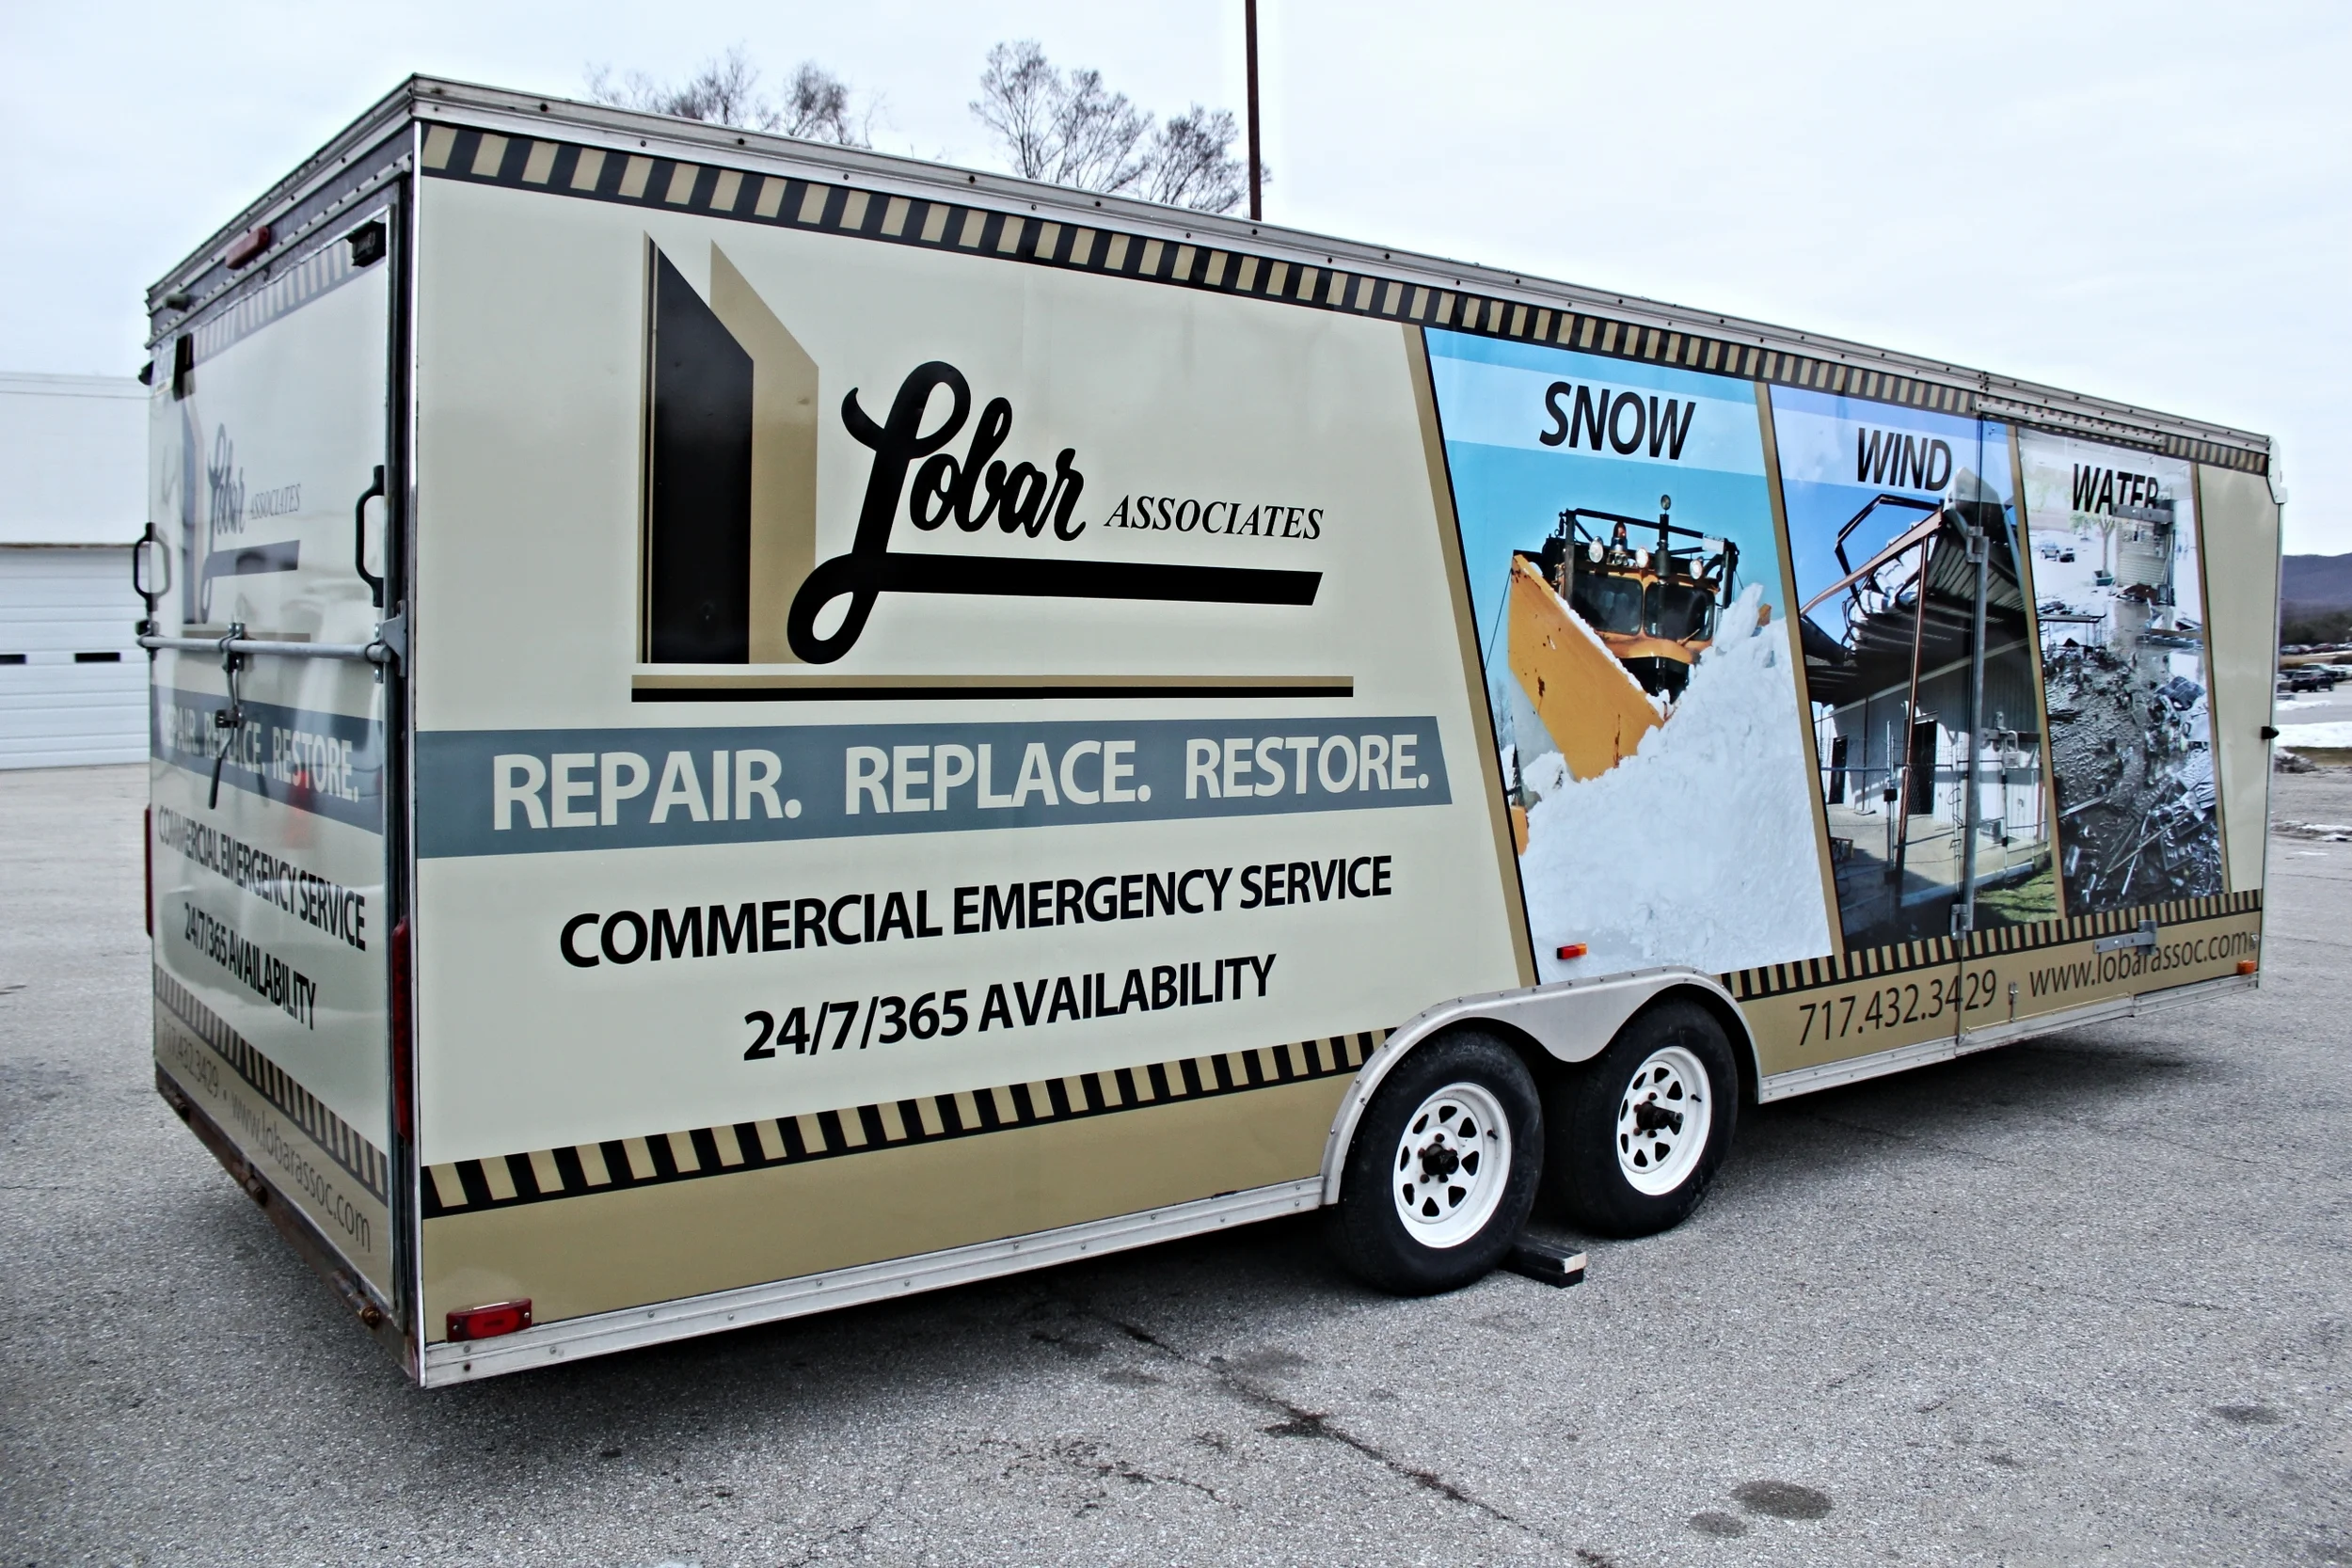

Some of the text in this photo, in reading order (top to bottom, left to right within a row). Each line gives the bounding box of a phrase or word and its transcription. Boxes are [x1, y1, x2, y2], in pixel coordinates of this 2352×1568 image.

[1538, 380, 1697, 461] SNOW
[1856, 426, 1952, 492] WIND
[787, 361, 1325, 664] Lobar ASSOCIATES
[2072, 463, 2159, 516] WATER
[272, 725, 360, 804] RESTORE.
[493, 733, 1430, 832] REPAIR. REPLACE. RESTORE.
[221, 833, 299, 915] EMERGENCY
[298, 868, 367, 952] SERVICE
[559, 854, 1392, 969] COMMERCIAL EMERGENCY SERVICE
[184, 901, 317, 1031] 24/7/365 AVAILABILITY
[742, 952, 1278, 1062] 24/7/365 AVAILABILITY
[1799, 931, 2248, 1046] 717.432.3429 www.lobarassoc.com
[230, 1088, 372, 1254] www.lobarassoc.com
